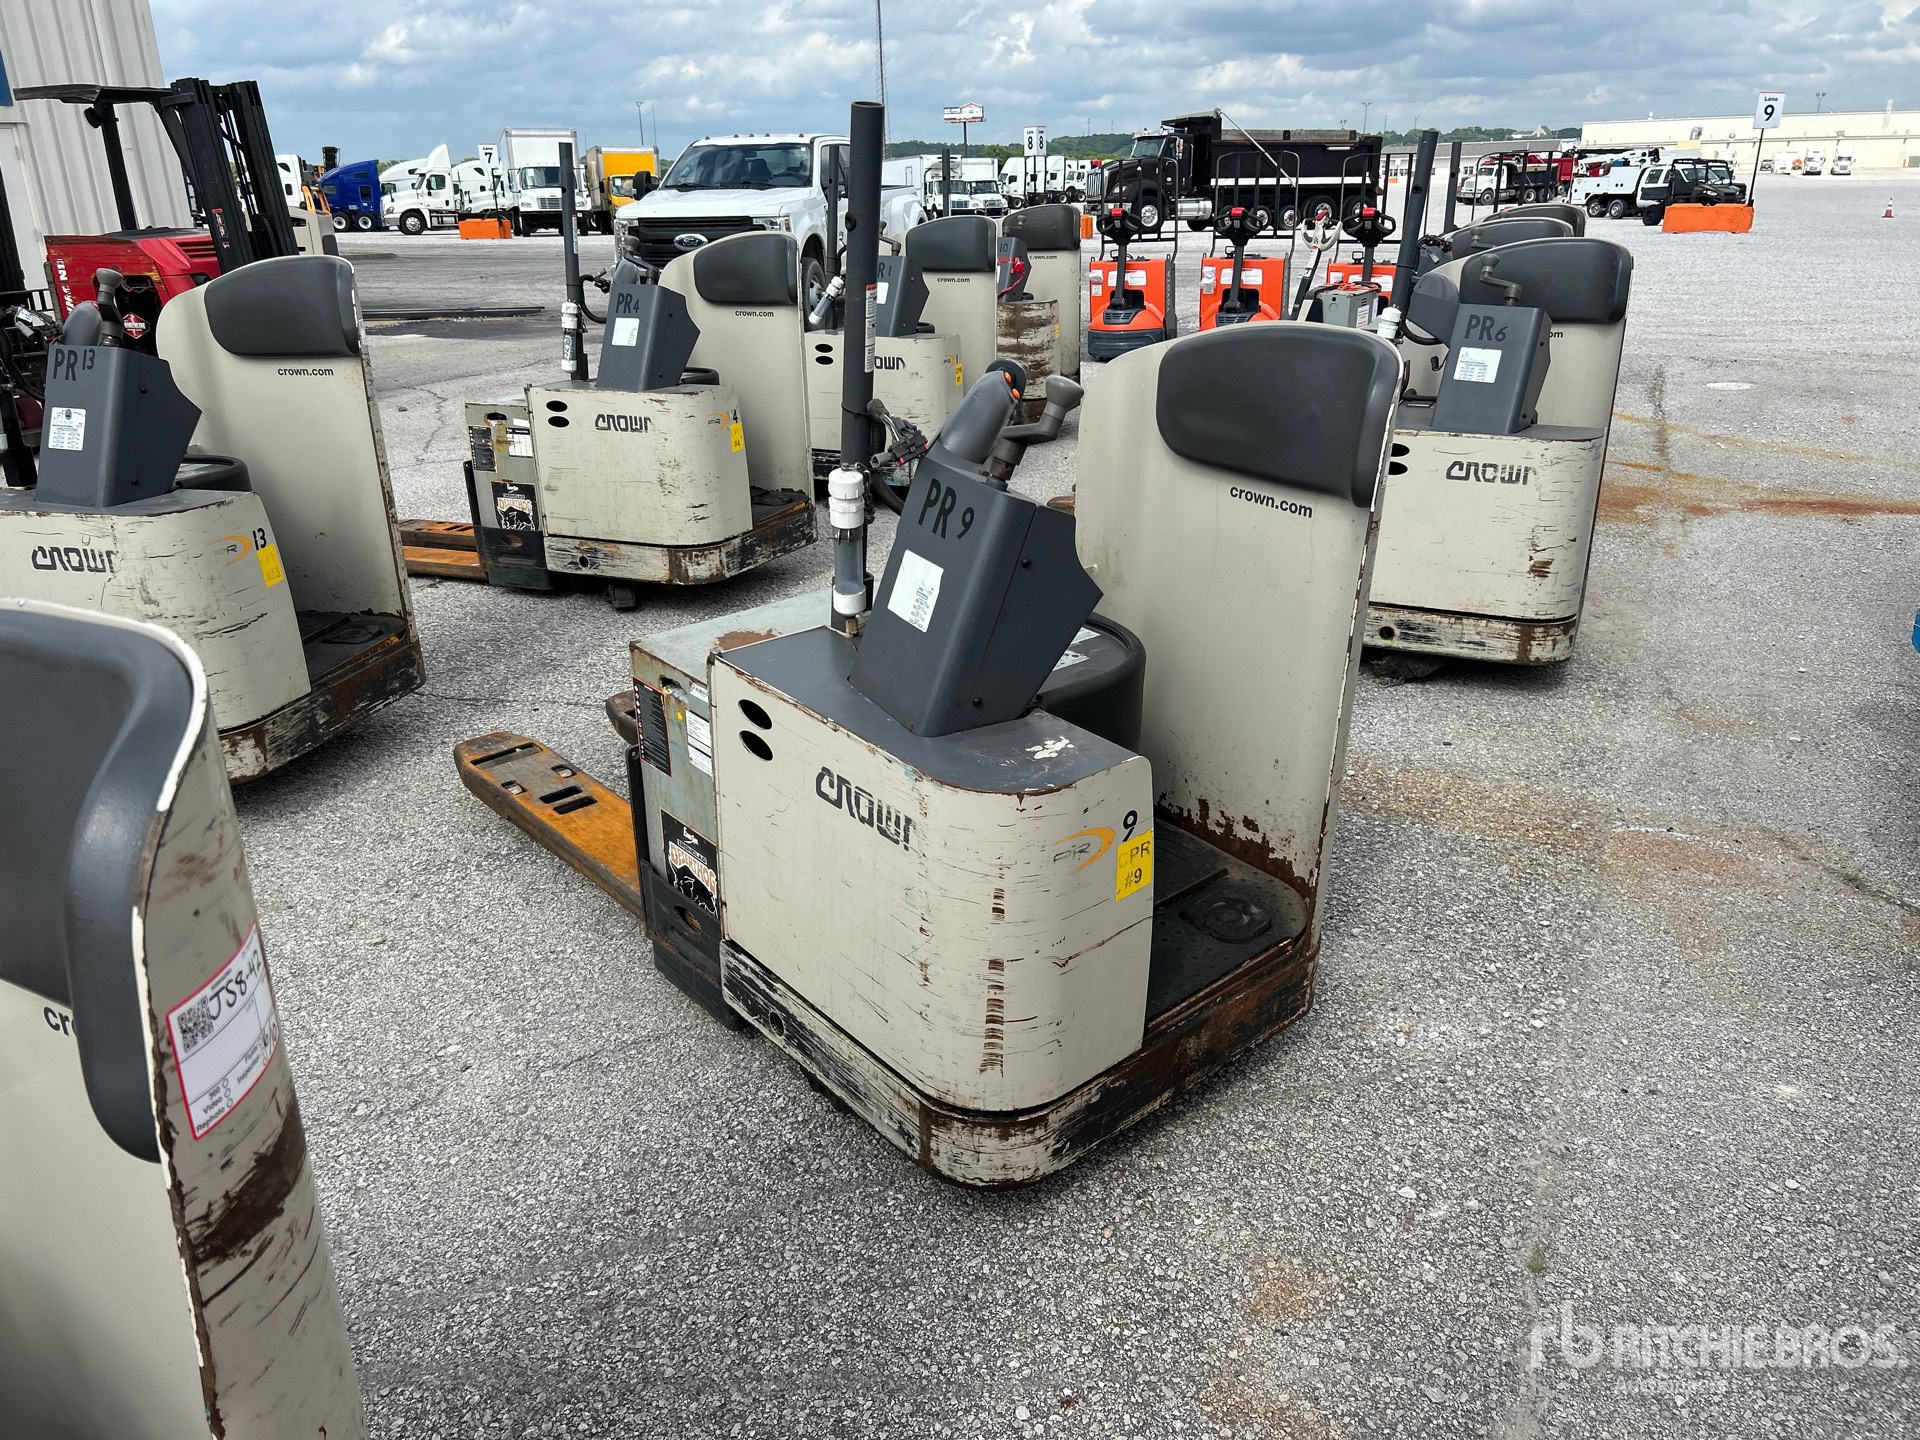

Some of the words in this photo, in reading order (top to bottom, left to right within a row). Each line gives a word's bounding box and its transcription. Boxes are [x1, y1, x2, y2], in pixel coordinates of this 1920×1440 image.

[1764, 104, 1775, 122] 9
[1027, 135, 1034, 150] 8
[1038, 135, 1044, 150] 8
[484, 151, 493, 164] 7
[1000, 243, 1009, 252] 10
[878, 261, 886, 278] R
[616, 292, 633, 314] PR
[633, 299, 640, 314] 4
[734, 309, 774, 318] crown.com
[1464, 314, 1496, 342] PR
[1495, 326, 1509, 343] 6
[53, 349, 77, 381] PR
[82, 349, 96, 371] 13
[277, 368, 335, 377] crown.com
[918, 478, 957, 540] PR
[956, 507, 975, 540] 9
[1229, 486, 1313, 519] crown.com
[252, 527, 267, 551] 13
[1122, 810, 1138, 843] 9
[1124, 867, 1143, 890] #9
[209, 949, 262, 1021] JS8-42
[203, 1096, 223, 1114] Video
[196, 1106, 226, 1133] Rephoto
